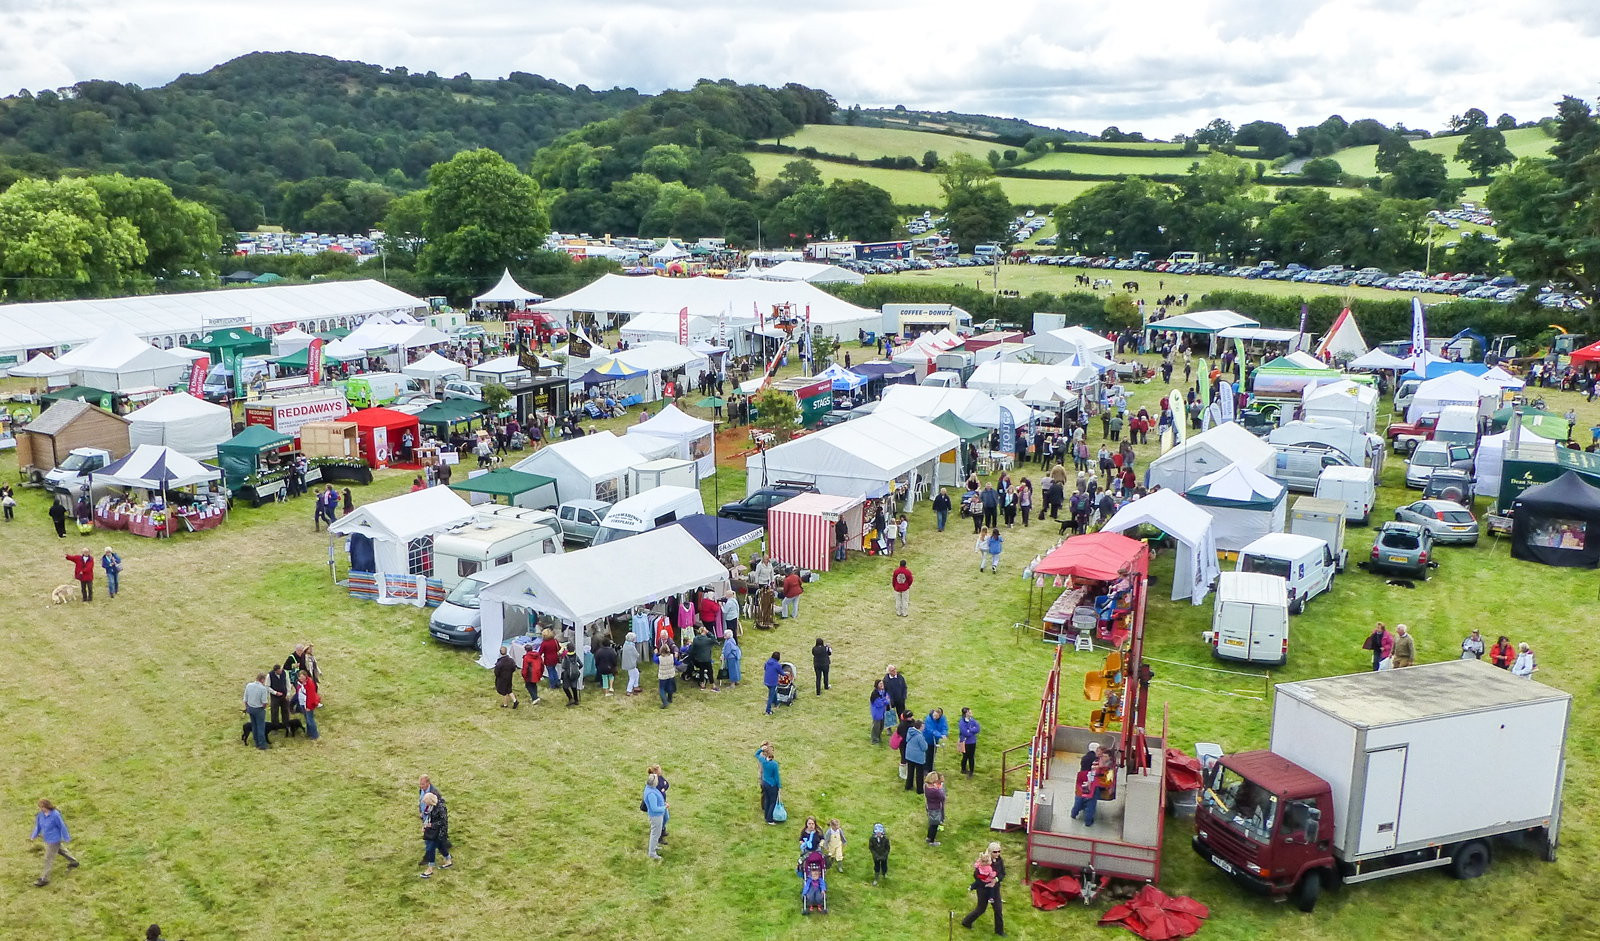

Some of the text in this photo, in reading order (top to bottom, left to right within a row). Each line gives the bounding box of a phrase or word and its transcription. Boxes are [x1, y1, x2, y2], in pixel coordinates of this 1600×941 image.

[191, 364, 201, 387] Chimney
[196, 369, 205, 396] Specialists
[277, 401, 342, 419] REDDAWAYS
[813, 396, 831, 410] STAGS
